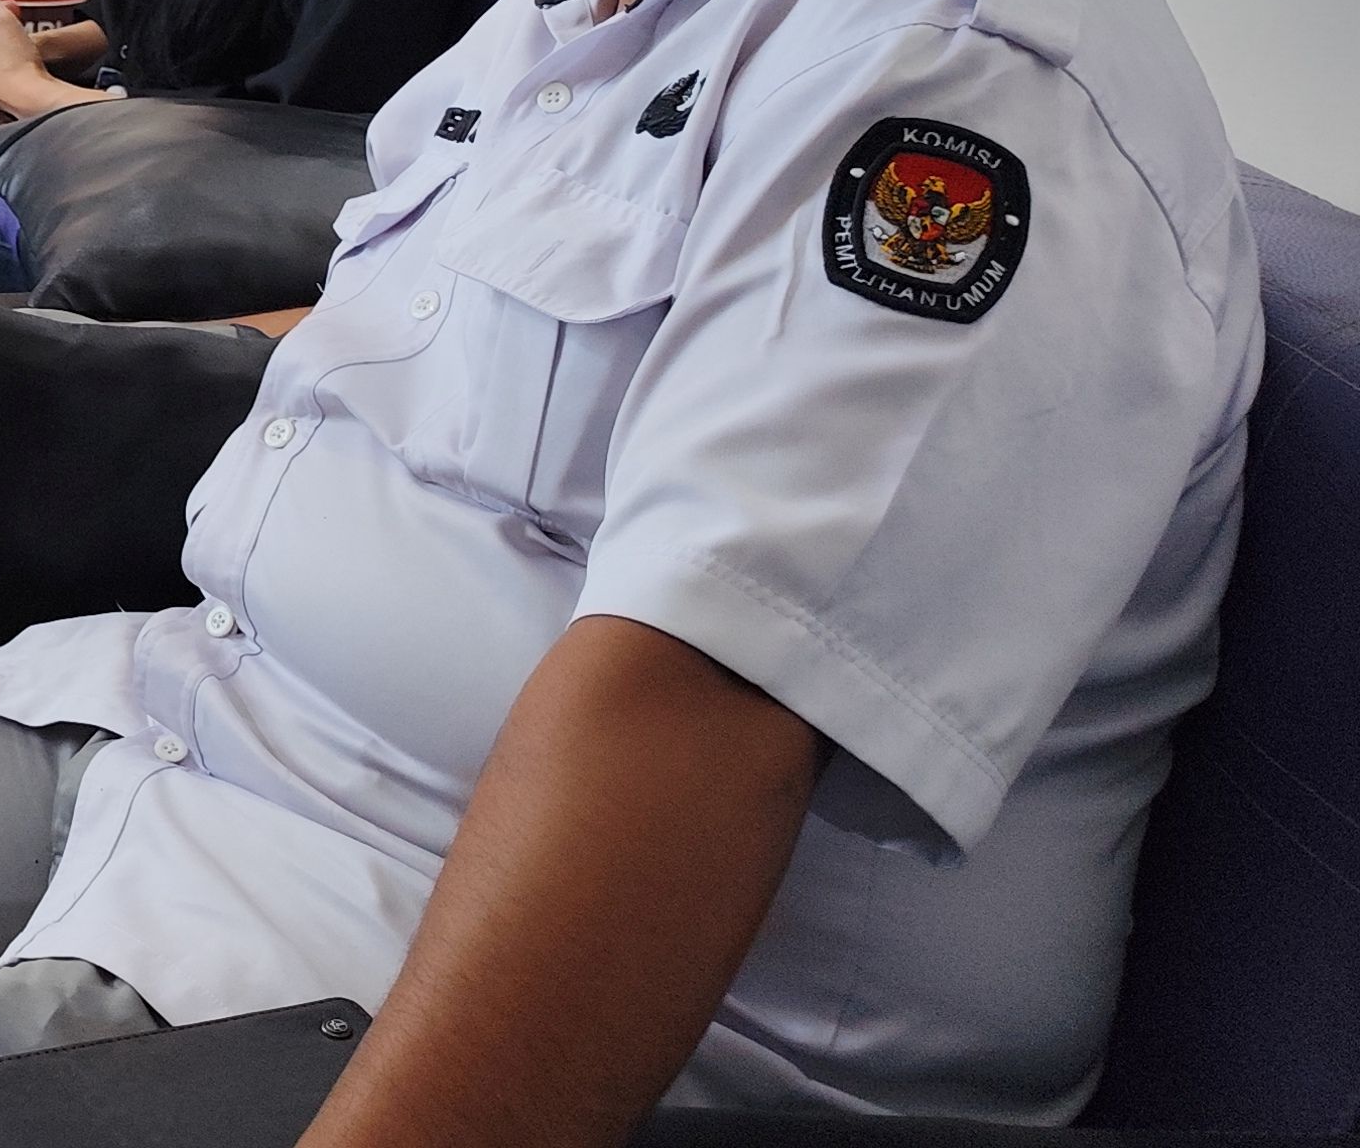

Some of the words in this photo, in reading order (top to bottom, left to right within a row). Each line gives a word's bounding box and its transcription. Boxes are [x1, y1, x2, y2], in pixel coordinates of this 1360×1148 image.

[902, 127, 1003, 170] KOMISI
[834, 213, 938, 308] PEMILIHAN
[945, 258, 1008, 312] UMUM
